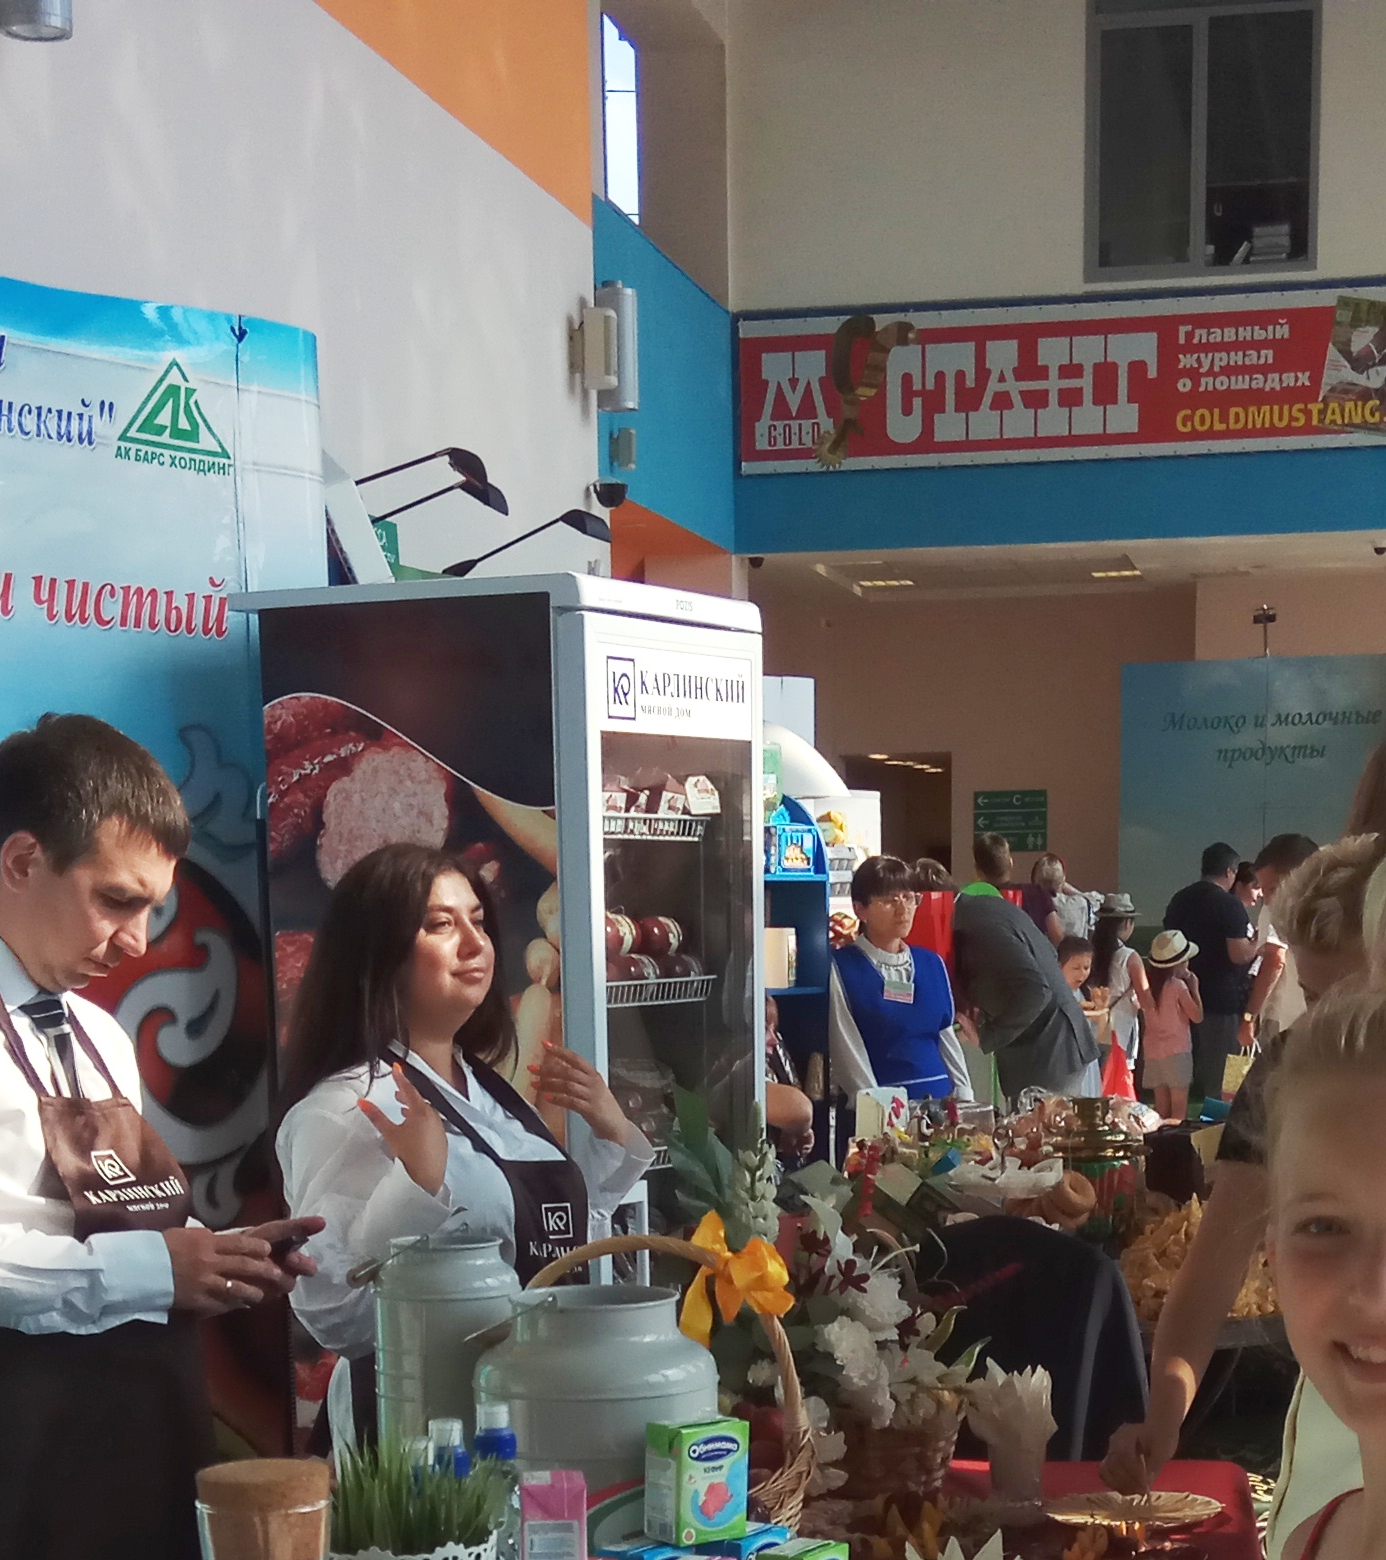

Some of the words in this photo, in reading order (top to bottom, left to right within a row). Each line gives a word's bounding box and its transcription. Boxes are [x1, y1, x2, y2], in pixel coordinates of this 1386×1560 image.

[1177, 318, 1291, 346] Главный
[1177, 345, 1275, 373] журнал
[1177, 376, 1192, 392] о
[1199, 371, 1312, 397] лошадях
[114, 447, 132, 461] АК
[134, 450, 166, 467] БАРС
[168, 453, 233, 477] ХОЛДИНГ
[31, 577, 229, 639] чистый
[640, 669, 746, 704] КАРЛИНСКИЙ
[1162, 711, 1247, 734] Молоко
[1253, 714, 1267, 729] и
[1271, 708, 1382, 728] молочные
[1216, 739, 1327, 769] продукты
[83, 1175, 185, 1205] КАРЛИНСКИЙ
